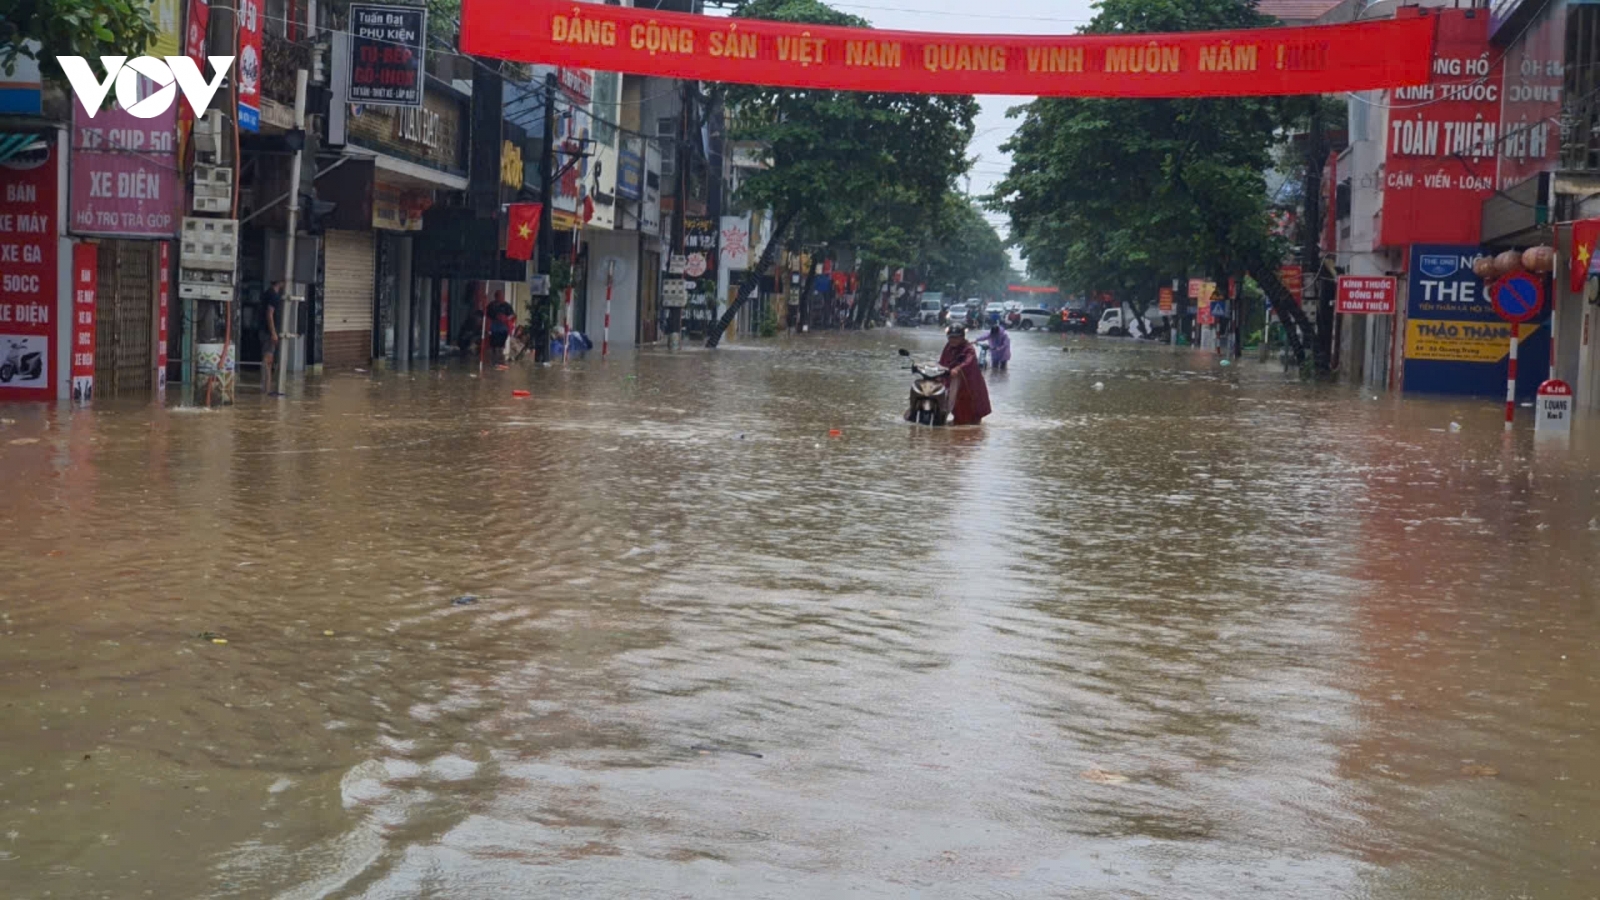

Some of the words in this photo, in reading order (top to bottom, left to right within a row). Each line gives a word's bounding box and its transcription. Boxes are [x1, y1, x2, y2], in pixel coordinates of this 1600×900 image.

[387, 28, 415, 42] KIỆN
[553, 7, 616, 46] ĐẢNG
[631, 20, 693, 55] CỘNG
[709, 23, 757, 59] SẢN
[777, 32, 826, 67] VIỆT
[846, 40, 901, 67] NAM
[924, 45, 1006, 72] QUANG
[1027, 46, 1083, 73] VINH
[1105, 41, 1180, 73] MUÔN
[1199, 40, 1257, 72] NĂM
[1433, 52, 1460, 75] NG
[1466, 52, 1489, 76] HỒ
[1440, 76, 1497, 101] THUỐC
[81, 128, 103, 153] XE
[109, 129, 145, 155] CUP
[151, 131, 171, 157] 50
[1392, 112, 1438, 156] TOÀN
[1444, 113, 1496, 164] THIỆN
[7, 180, 36, 202] BÁN
[90, 171, 112, 198] XE
[118, 167, 160, 205] ĐIỆN
[1388, 170, 1413, 190] CẬN
[17, 211, 48, 232] MÁY
[1, 245, 19, 262] XE
[23, 245, 41, 262] GA
[3, 275, 40, 293] 50CC
[1420, 280, 1475, 303] THE
[16, 301, 49, 326] ĐIỆN
